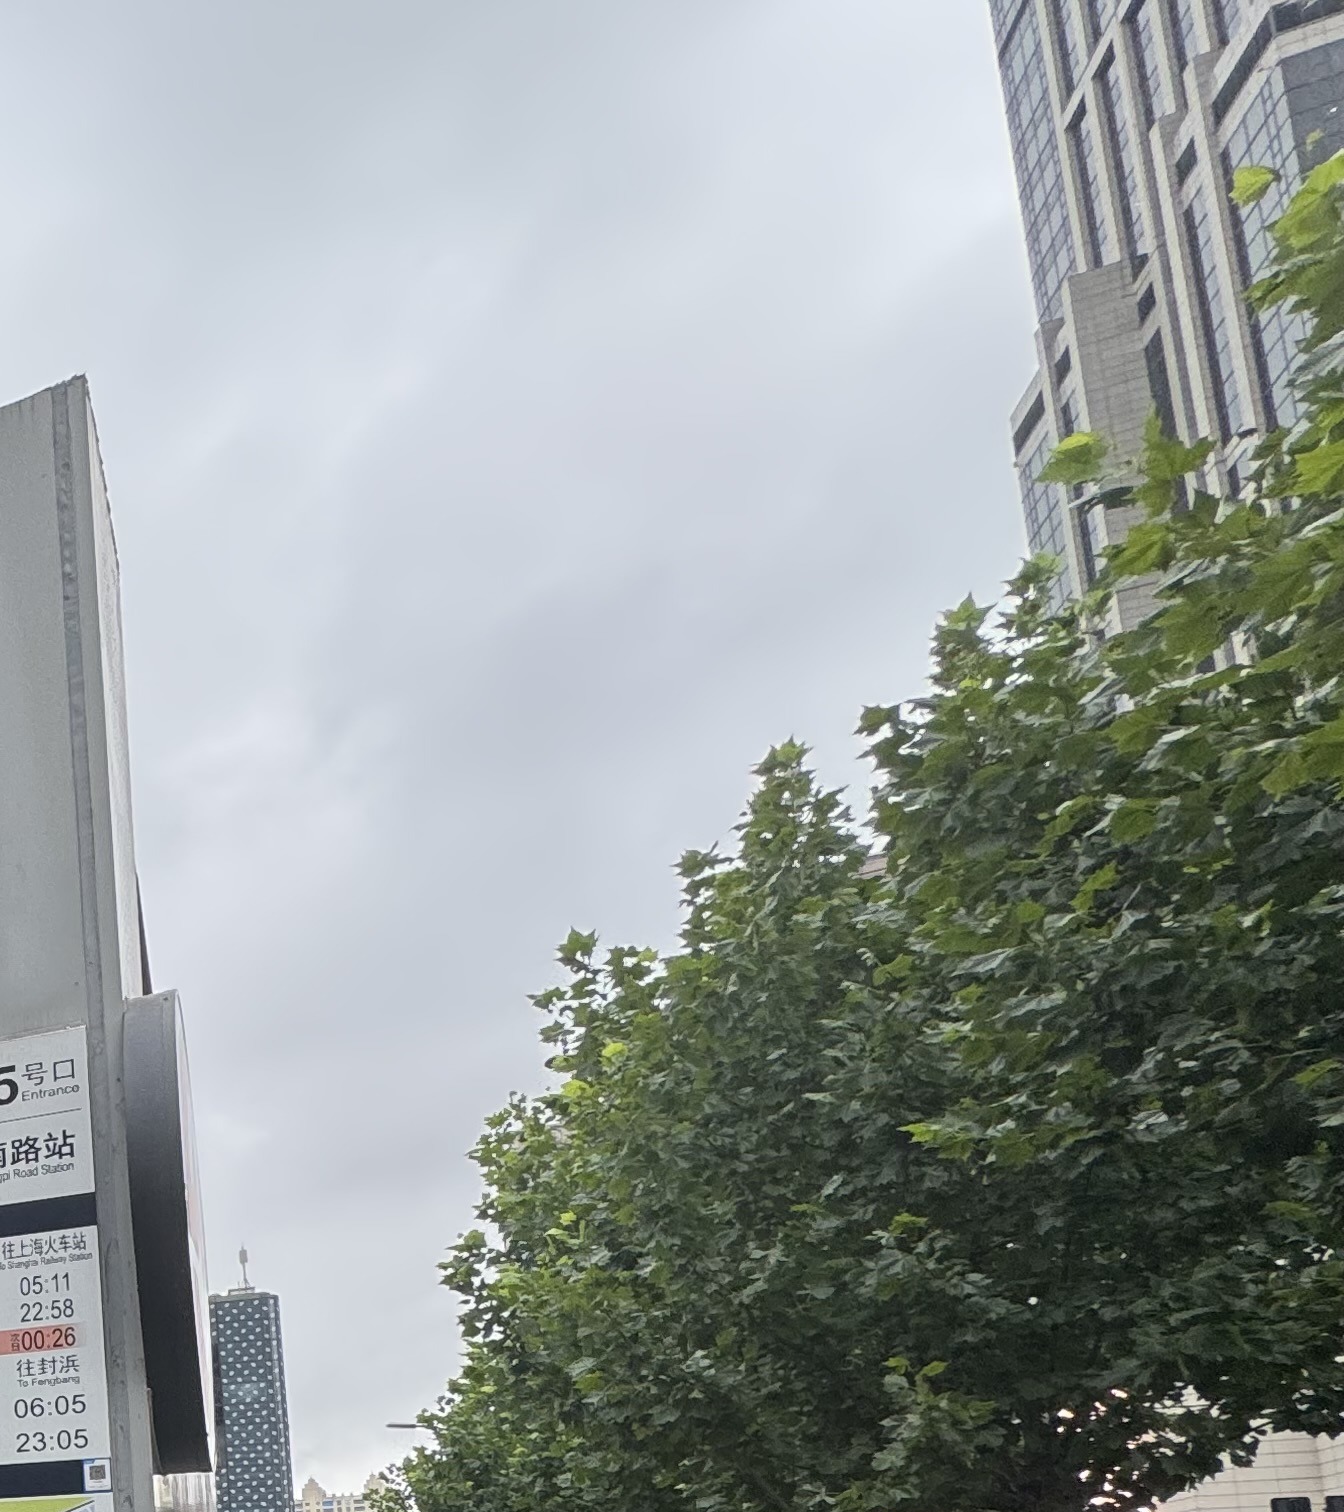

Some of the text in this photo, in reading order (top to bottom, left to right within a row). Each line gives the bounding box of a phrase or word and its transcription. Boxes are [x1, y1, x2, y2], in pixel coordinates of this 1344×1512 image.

[13, 1165, 39, 1178] Road
[41, 1162, 75, 1175] Station
[2, 1231, 87, 1260] 往上海火车站
[19, 1271, 70, 1296] 05:11
[20, 1298, 75, 1323] 22:58
[21, 1326, 76, 1351] 00:26
[17, 1379, 29, 1388] To
[14, 1394, 87, 1418] 06:05
[16, 1428, 89, 1453] 23:05
